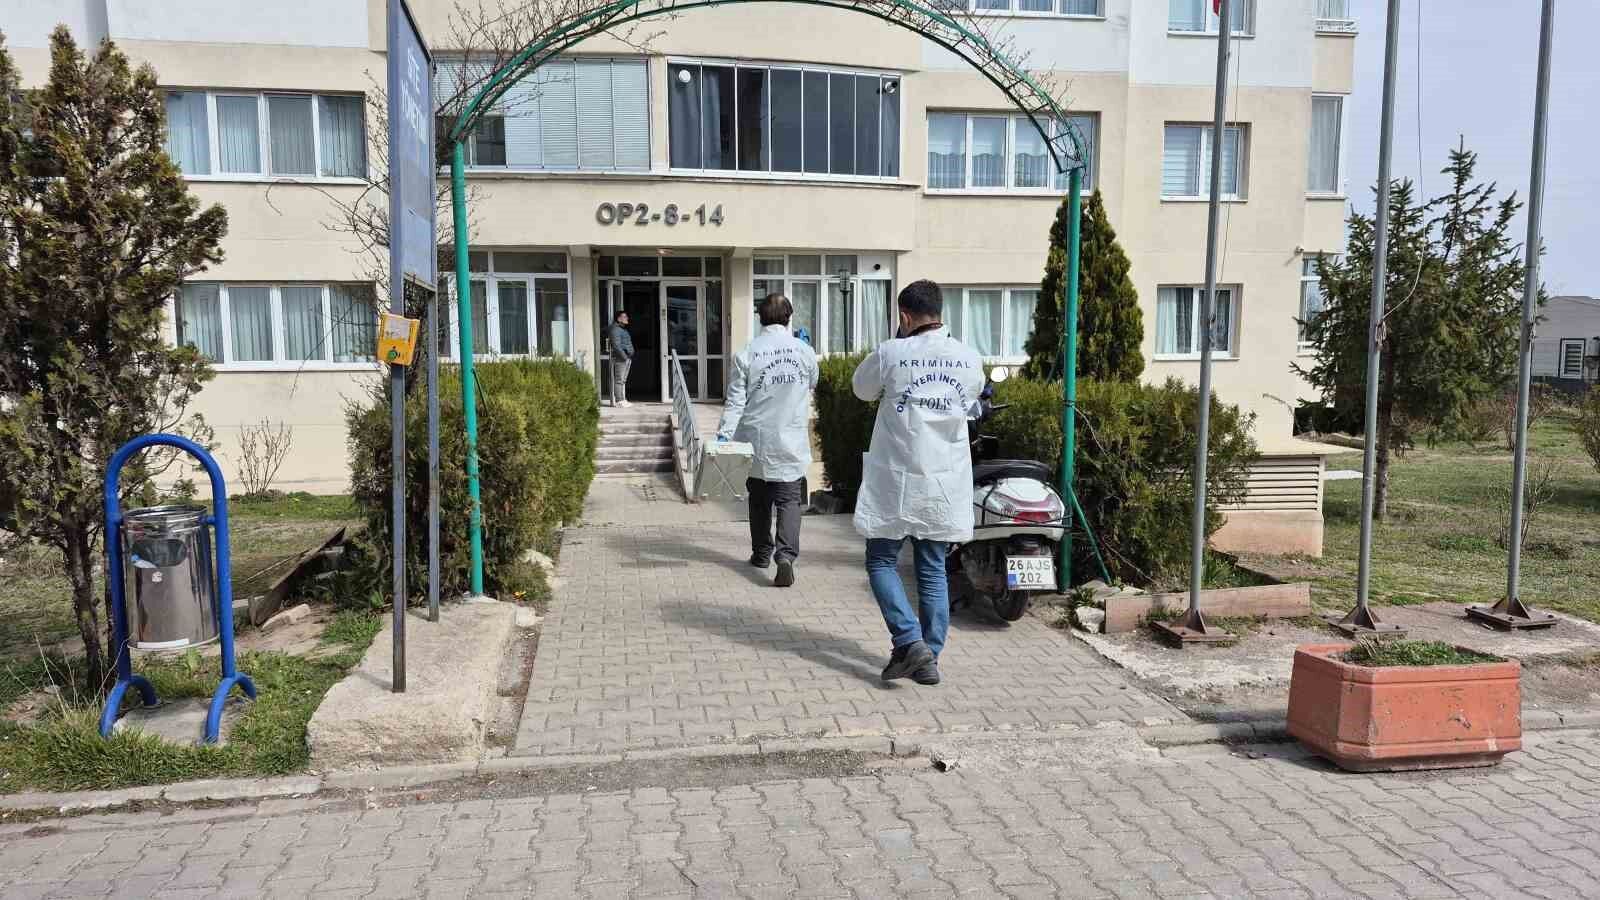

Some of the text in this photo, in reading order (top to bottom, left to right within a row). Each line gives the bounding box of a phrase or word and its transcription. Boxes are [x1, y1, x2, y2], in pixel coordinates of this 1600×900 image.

[596, 202, 724, 226] OP2-8-14
[1009, 559, 1050, 571] 26 AJS
[1019, 572, 1042, 584] 202
